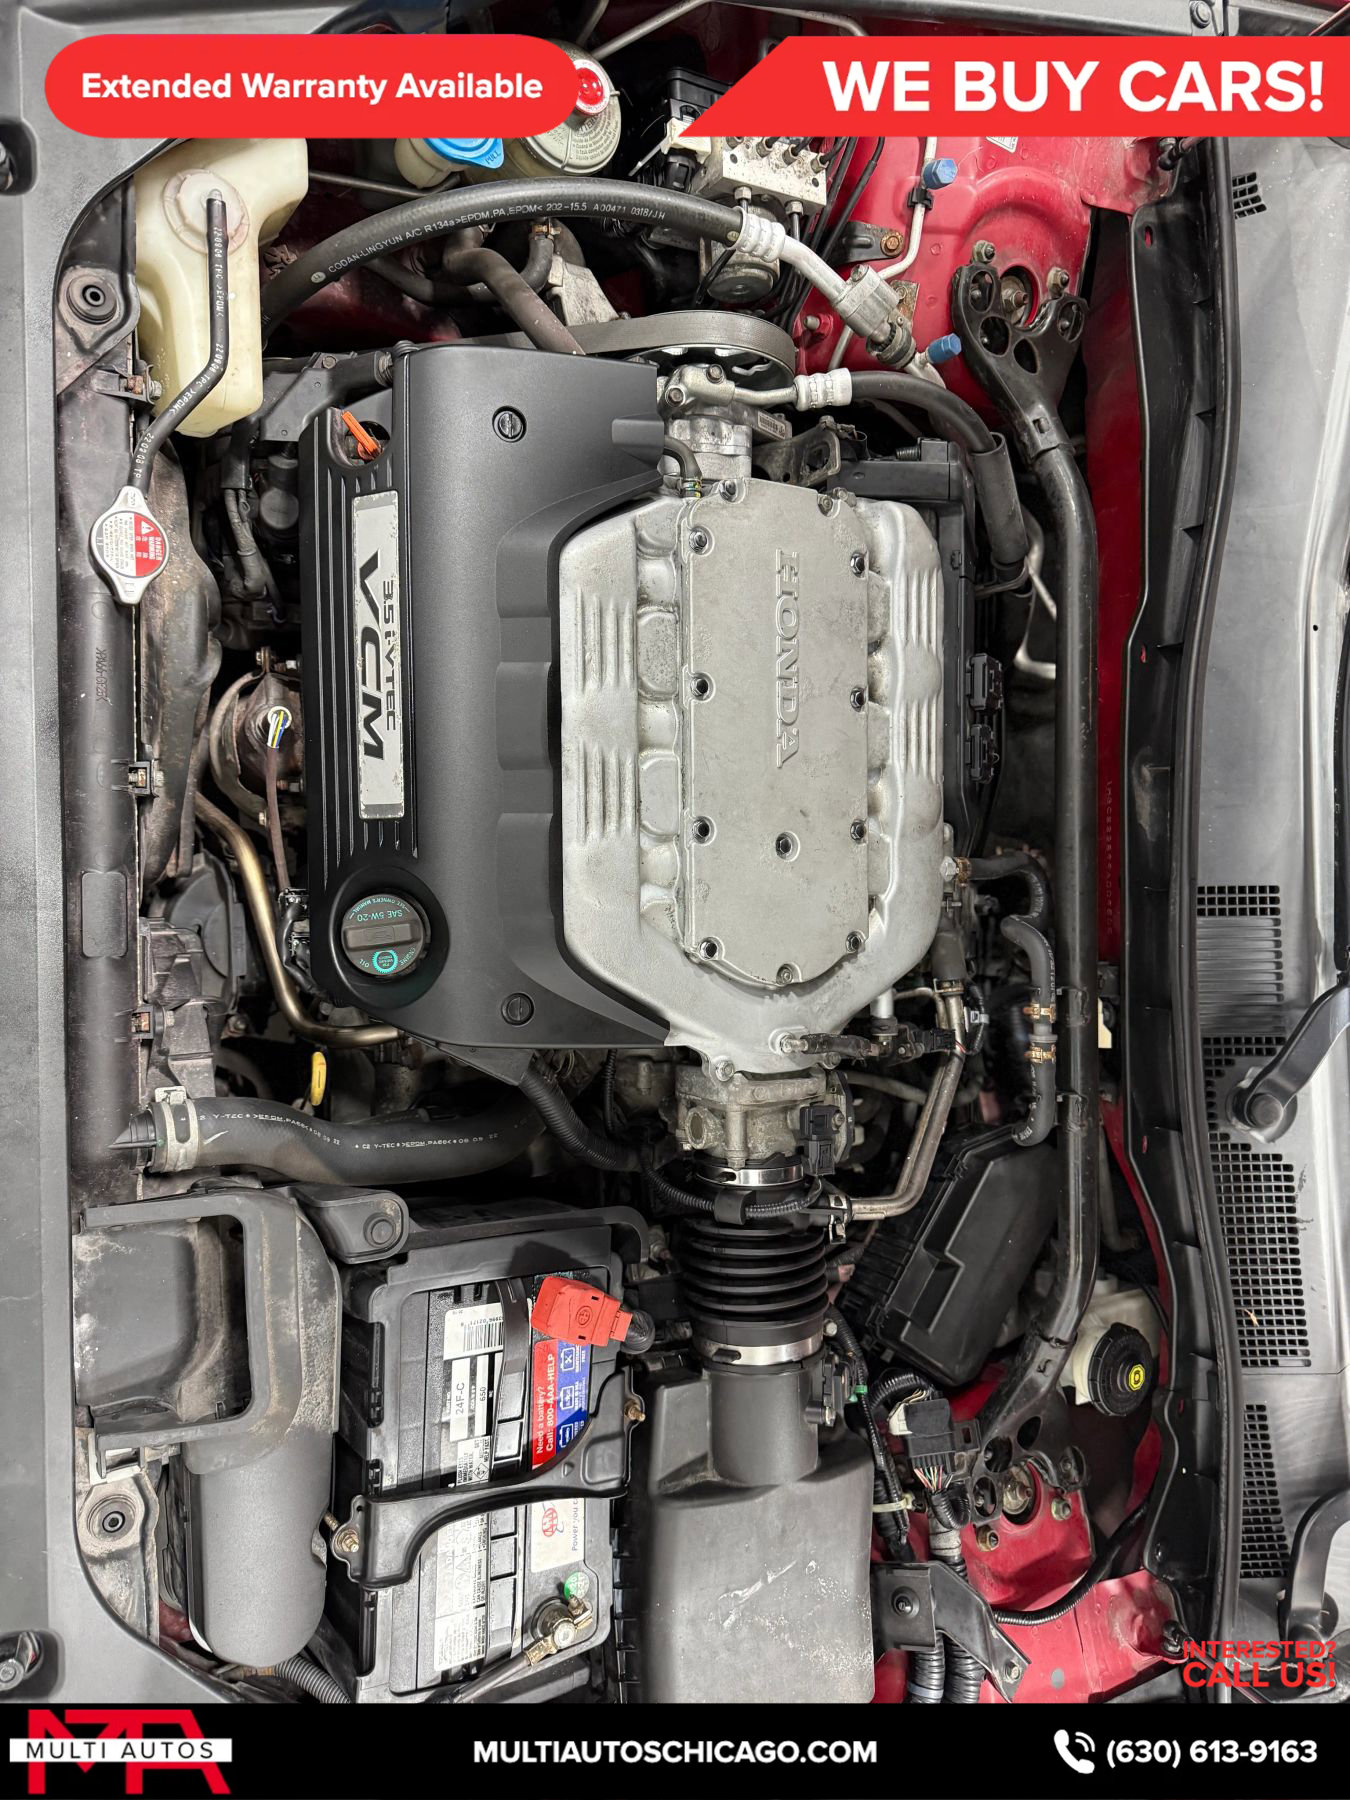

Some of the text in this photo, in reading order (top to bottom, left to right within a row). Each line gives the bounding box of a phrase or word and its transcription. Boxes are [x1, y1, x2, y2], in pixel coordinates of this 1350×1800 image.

[484, 150, 502, 165] PULL
[328, 234, 403, 274] CODAN-LINGYUN
[405, 228, 422, 240] A/C
[383, 579, 395, 625] 3.5
[359, 549, 385, 760] VCM
[775, 548, 800, 769] HONDA
[357, 909, 403, 922] SAE 5W-20
[456, 1382, 465, 1415] 24F-C
[479, 1386, 487, 1402] 650
[537, 1386, 546, 1421] battery?
[546, 1353, 555, 1452] Call: 800-AAA-HELP
[536, 1430, 544, 1454] Need
